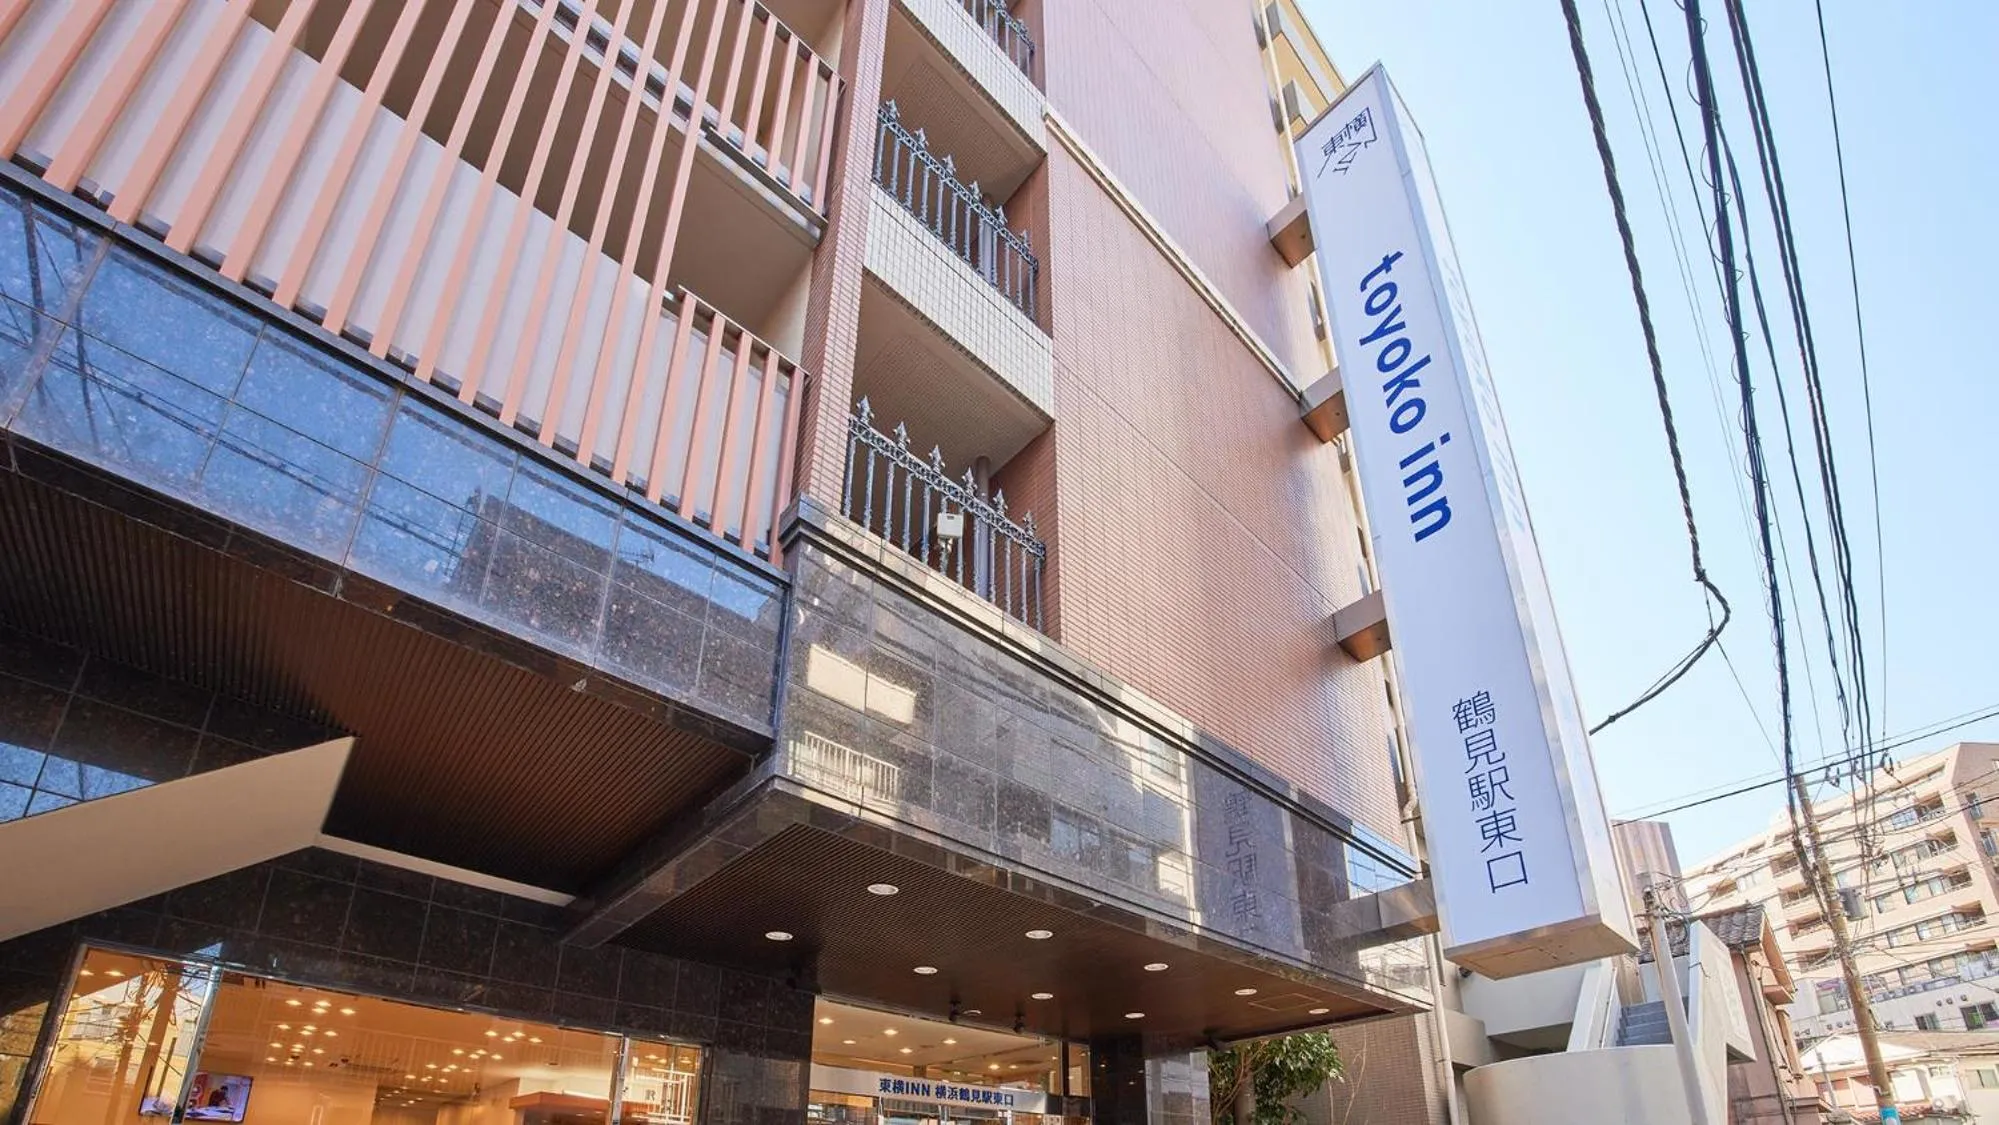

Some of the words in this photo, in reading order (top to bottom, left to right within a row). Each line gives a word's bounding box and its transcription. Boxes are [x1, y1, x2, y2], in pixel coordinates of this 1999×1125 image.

[1358, 250, 1432, 434] toyoko
[1398, 432, 1452, 543] inn
[1452, 690, 1528, 894] 鶴見駅東口
[879, 1077, 930, 1097] 東横INN
[935, 1084, 1014, 1107] 横浜鶴見駅東口
